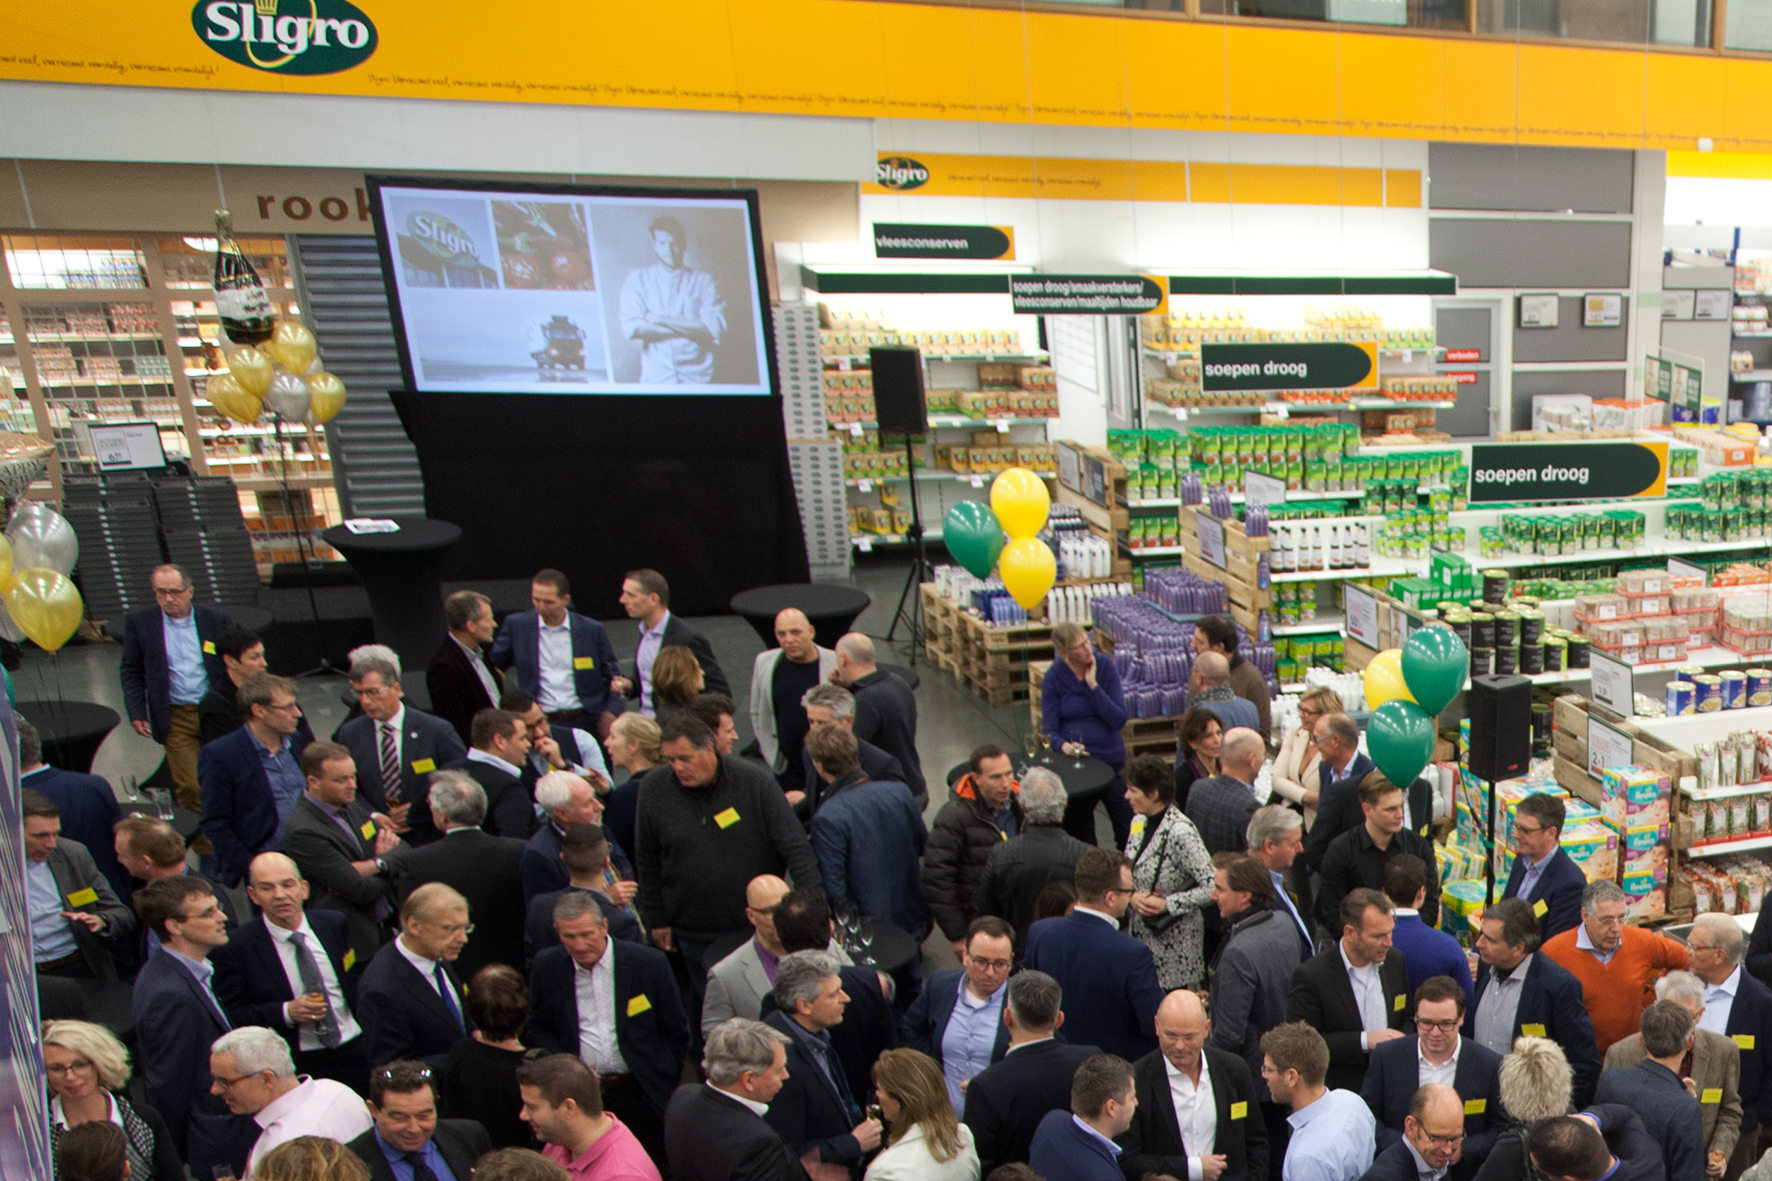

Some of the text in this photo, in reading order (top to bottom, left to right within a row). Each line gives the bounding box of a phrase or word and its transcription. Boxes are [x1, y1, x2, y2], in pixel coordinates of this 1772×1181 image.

[205, 1, 369, 55] Sligro
[877, 163, 928, 184] Sligro
[413, 209, 480, 259] Sligro
[876, 235, 969, 250] vleesconserven
[1204, 360, 1307, 378] soepen droog
[1474, 463, 1590, 485] soepen droog
